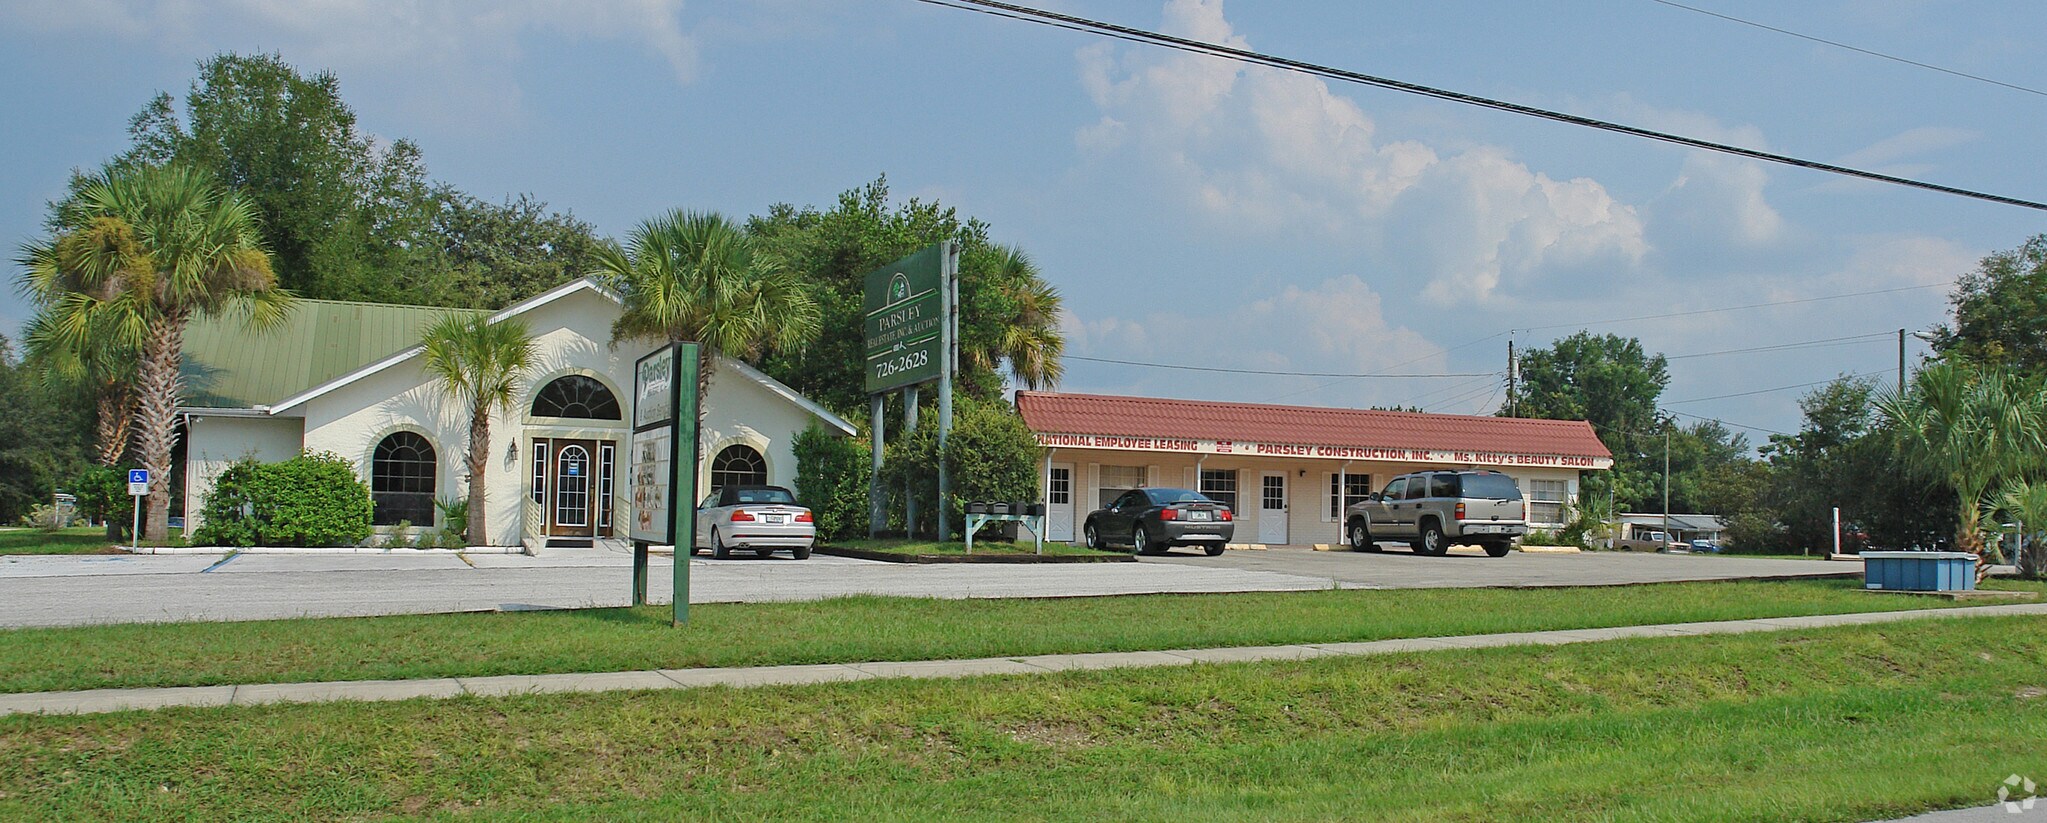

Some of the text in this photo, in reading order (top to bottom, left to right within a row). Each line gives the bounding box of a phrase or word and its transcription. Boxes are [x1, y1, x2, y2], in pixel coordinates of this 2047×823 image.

[879, 303, 922, 332] PARSLEY
[913, 315, 940, 334] AUCTION
[641, 355, 671, 390] Parsley
[876, 350, 928, 378] 726-2628
[1036, 434, 1198, 451] NATIONAL EMPLOYEE LEASING
[1257, 443, 1433, 461] PARSLEY CONSTRUCTION, INC.
[1454, 452, 1594, 467] Ms. Kitty's BEAUTY SALON
